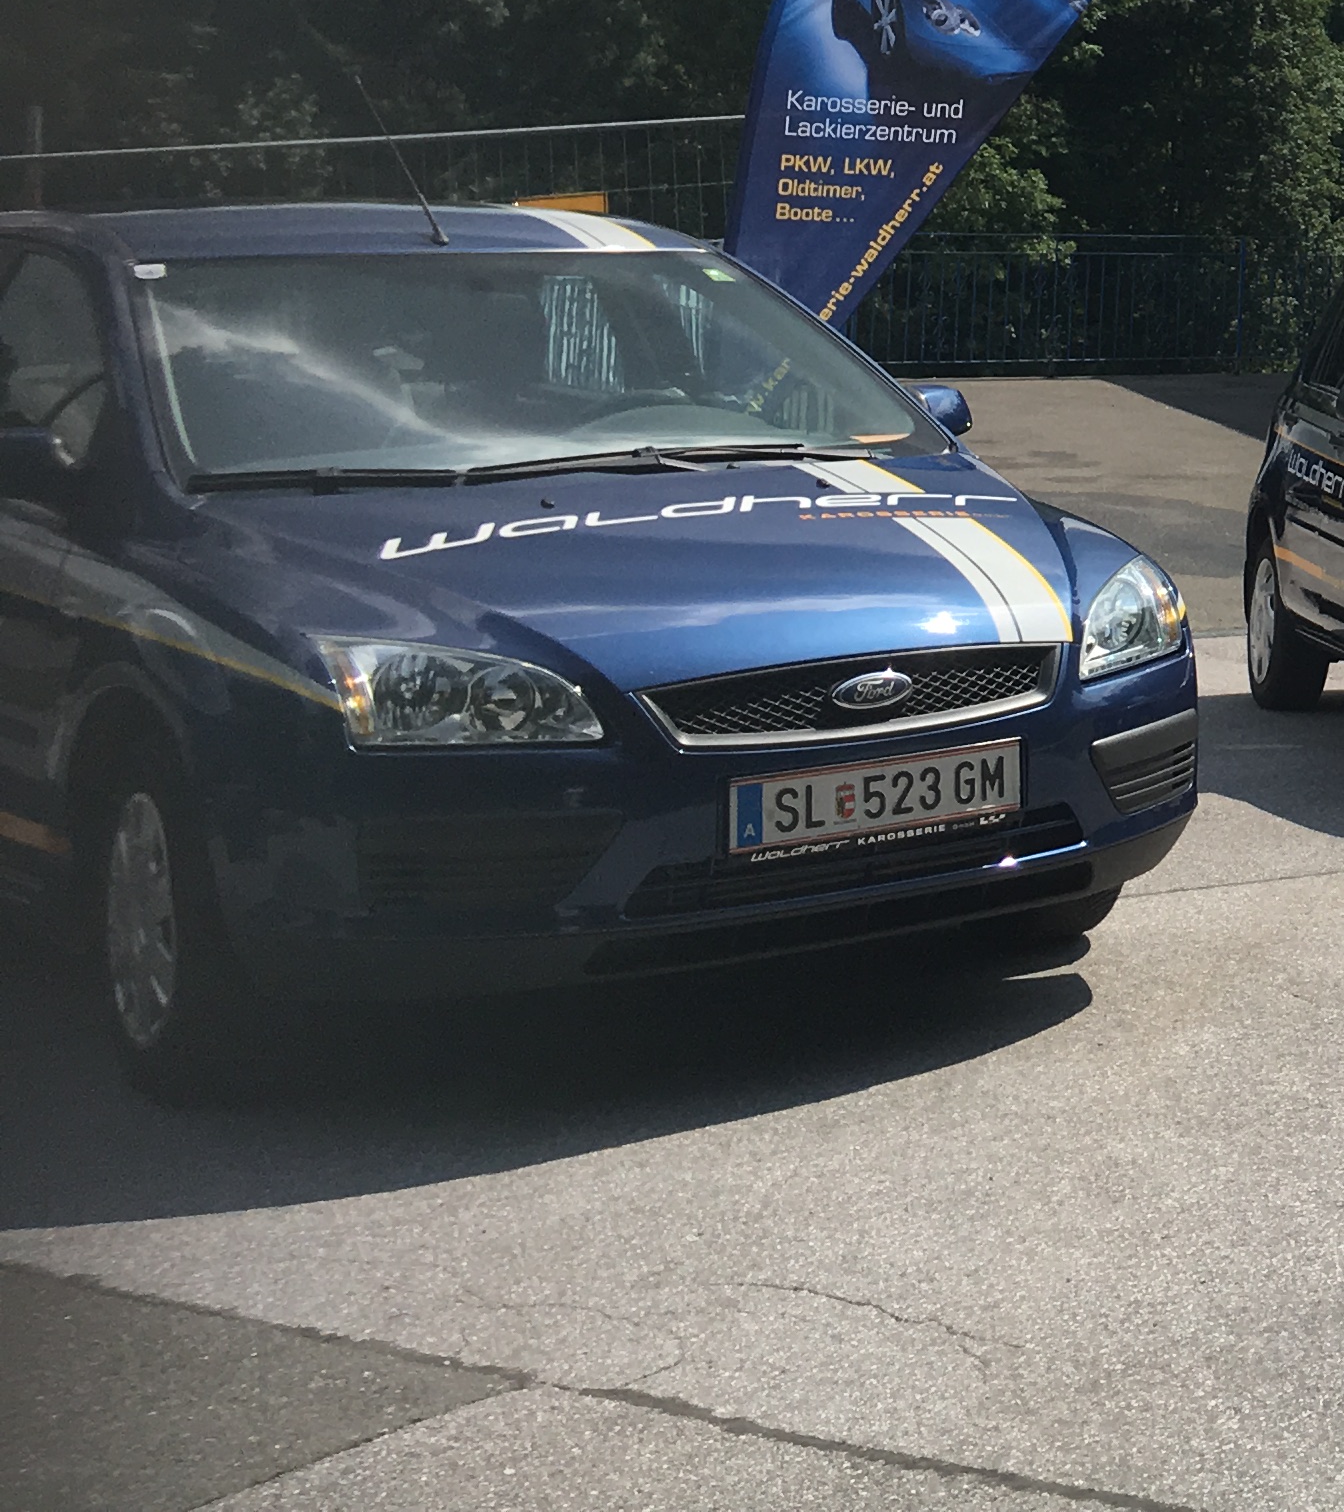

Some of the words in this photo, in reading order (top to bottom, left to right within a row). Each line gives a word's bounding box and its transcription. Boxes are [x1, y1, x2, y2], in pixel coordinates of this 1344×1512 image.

[786, 89, 916, 116] Karosserie-
[923, 99, 964, 118] und
[784, 115, 957, 144] Lackierzentrum
[780, 154, 835, 175] PKW,
[843, 157, 895, 178] LKW,
[778, 178, 865, 201] Oldtimer,
[853, 679, 895, 702] Ford
[774, 784, 826, 833] SL
[862, 766, 942, 820] 523
[953, 755, 1005, 805] GM
[743, 823, 756, 837] A
[857, 824, 946, 846] KAROSSERIE
